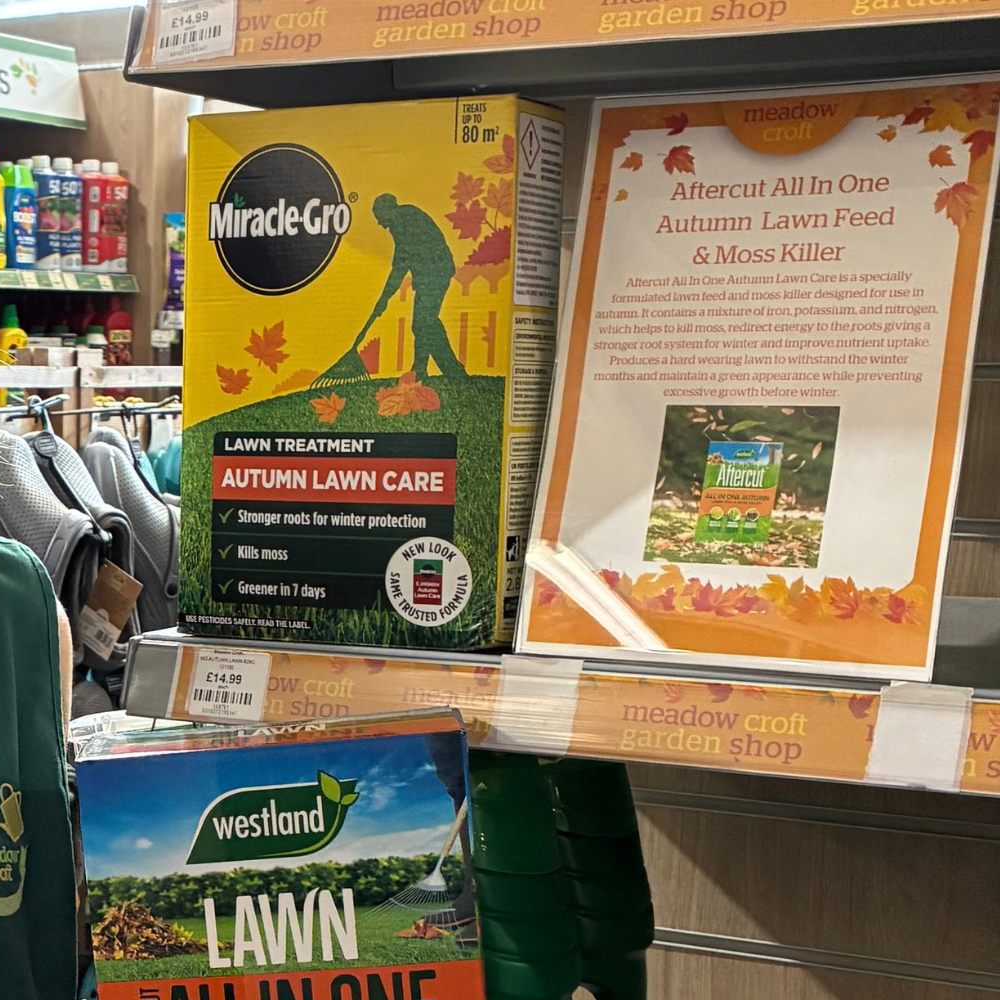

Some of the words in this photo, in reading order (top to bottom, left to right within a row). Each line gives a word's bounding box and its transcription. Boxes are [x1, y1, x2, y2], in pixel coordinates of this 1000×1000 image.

[171, 11, 209, 28] £14.99
[373, 20, 466, 48] garden
[473, 15, 541, 40] shop
[462, 102, 487, 114] TREATS
[742, 101, 840, 123] meadow
[462, 114, 472, 125] UP
[473, 114, 482, 124] TO
[462, 126, 479, 143] 80
[762, 122, 812, 142] croft
[670, 179, 767, 201] Aftercut
[770, 176, 804, 198] All
[808, 175, 833, 195] In
[838, 174, 890, 194] One
[209, 197, 351, 240] Miracle-Gro
[655, 214, 752, 234] Autumn
[761, 211, 828, 231] Lawn
[833, 206, 896, 229] Feed
[692, 245, 710, 265] &
[714, 244, 775, 265] Moss
[779, 242, 846, 263] Killer
[625, 276, 670, 288] Aftercut
[671, 276, 687, 287] All
[688, 276, 700, 286] In
[701, 275, 726, 286] One
[726, 274, 774, 286] Autumn
[776, 273, 808, 284] Lawn
[809, 272, 838, 283] Care
[838, 272, 849, 282] is
[849, 274, 858, 282] a
[858, 271, 913, 283] specially
[611, 292, 671, 304] formulated
[673, 291, 700, 302] lawn
[701, 291, 726, 302] feed
[727, 290, 750, 301] and
[751, 290, 781, 301] moss
[783, 289, 813, 300] killer
[814, 288, 868, 301] designed
[869, 288, 888, 299] for
[888, 288, 910, 298] use
[912, 288, 925, 298] in
[641, 308, 650, 319] It
[650, 307, 697, 318] contains
[698, 308, 706, 317] a
[706, 306, 752, 317] mixture
[752, 306, 766, 317] of
[859, 304, 883, 316] and
[225, 438, 271, 452] LAWN
[275, 438, 375, 453] TREATMENT
[221, 468, 307, 490] AUTUMN
[313, 470, 376, 491] LAWN
[382, 471, 444, 492] CARE
[715, 463, 765, 488] Aftercut
[238, 509, 281, 527] Stronger
[283, 512, 311, 526] roots
[313, 511, 328, 526] for
[331, 513, 366, 527] winter
[368, 514, 426, 530] protection
[238, 545, 259, 560] Kills
[261, 549, 288, 561] moss
[401, 541, 426, 562] NEW
[428, 541, 457, 563] LOOK
[238, 581, 278, 596] Greener
[280, 582, 291, 597] in
[292, 583, 299, 597] 7
[301, 583, 326, 599] days
[390, 571, 403, 600] SAME
[398, 598, 438, 623] TRUSTED
[438, 574, 469, 620] FORMULA
[185, 614, 197, 623] USE
[198, 615, 232, 625] PESTICIDES
[257, 619, 275, 627] READ
[275, 620, 288, 628] THE
[206, 671, 242, 684] £14.99
[621, 704, 740, 731] meadow
[743, 711, 808, 737] croft
[621, 725, 722, 754] garden
[729, 734, 803, 765] shop
[212, 795, 325, 841] westland
[203, 887, 359, 970] LAWN
